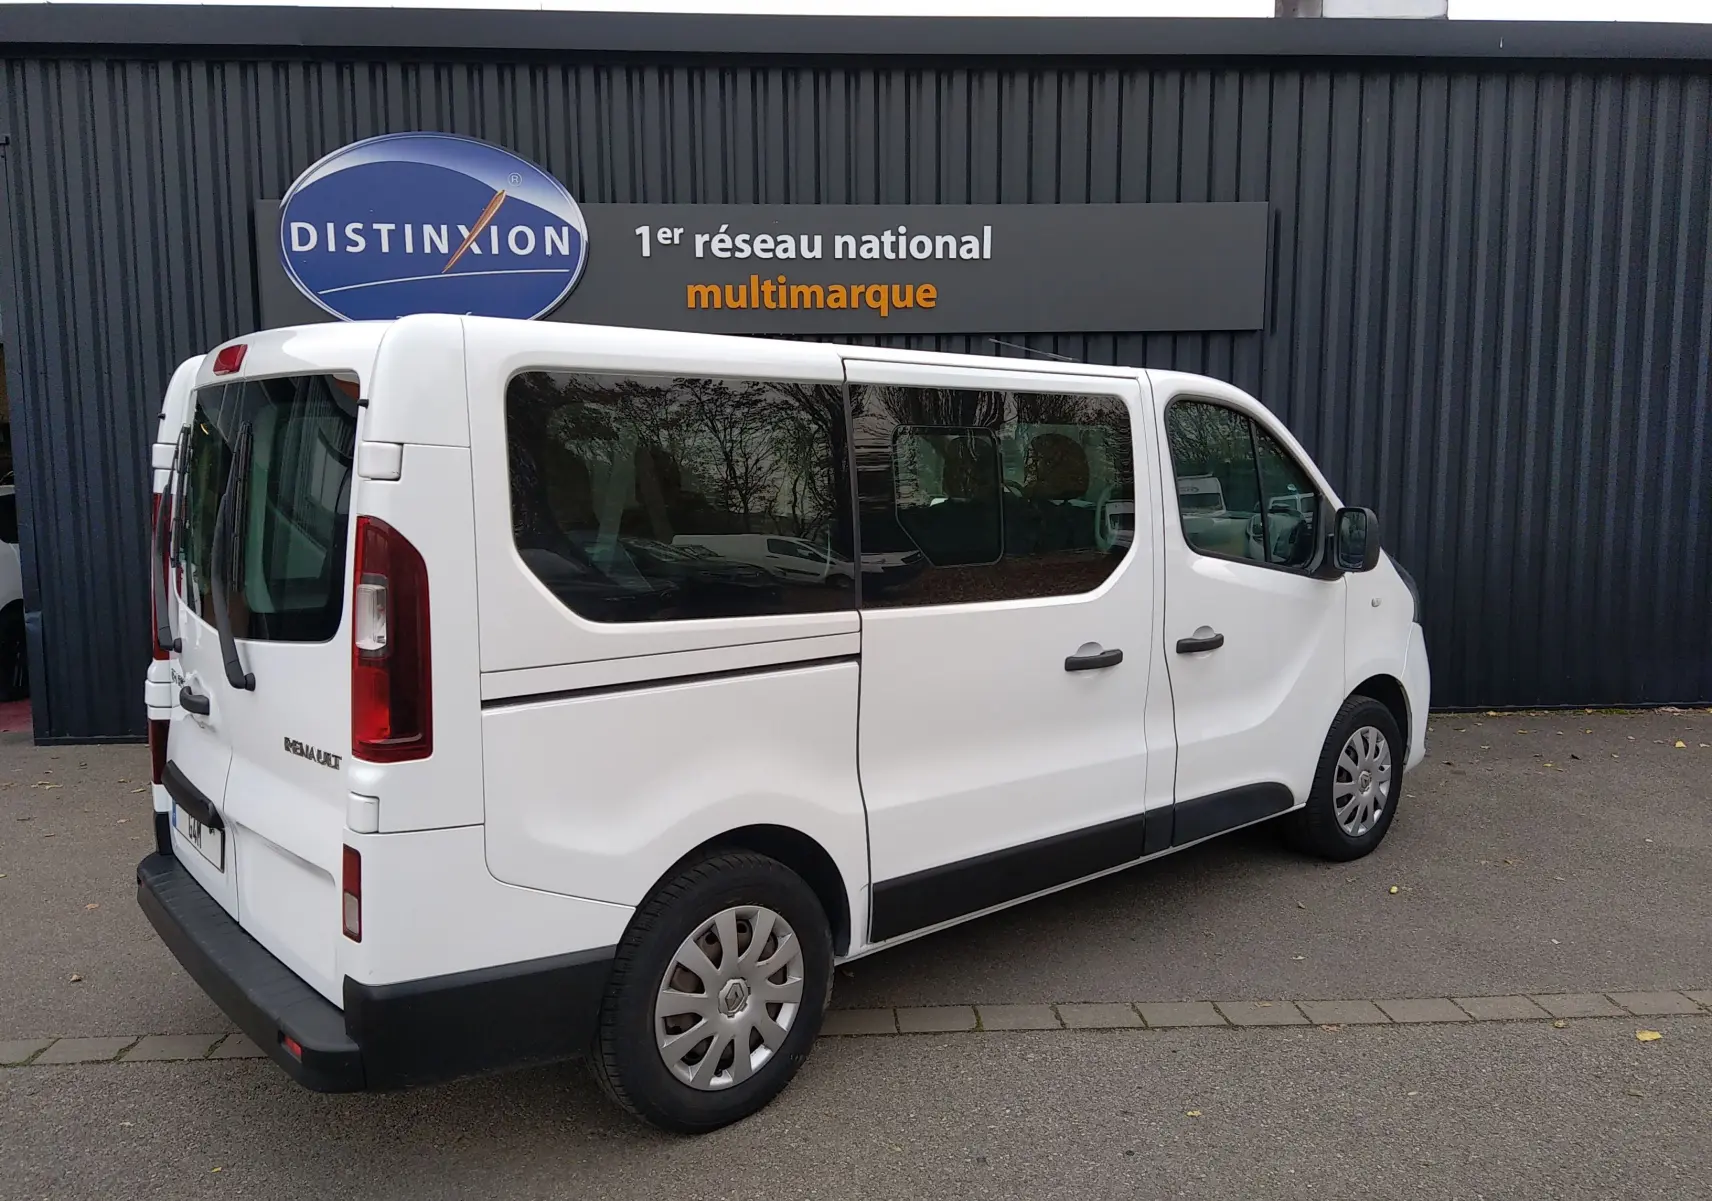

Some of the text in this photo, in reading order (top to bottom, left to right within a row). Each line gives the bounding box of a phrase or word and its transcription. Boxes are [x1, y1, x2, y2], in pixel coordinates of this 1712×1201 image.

[289, 221, 571, 256] DISTINXION
[635, 224, 992, 260] 1er réseau national
[687, 274, 938, 317] multimarque
[284, 736, 342, 770] RENAULT
